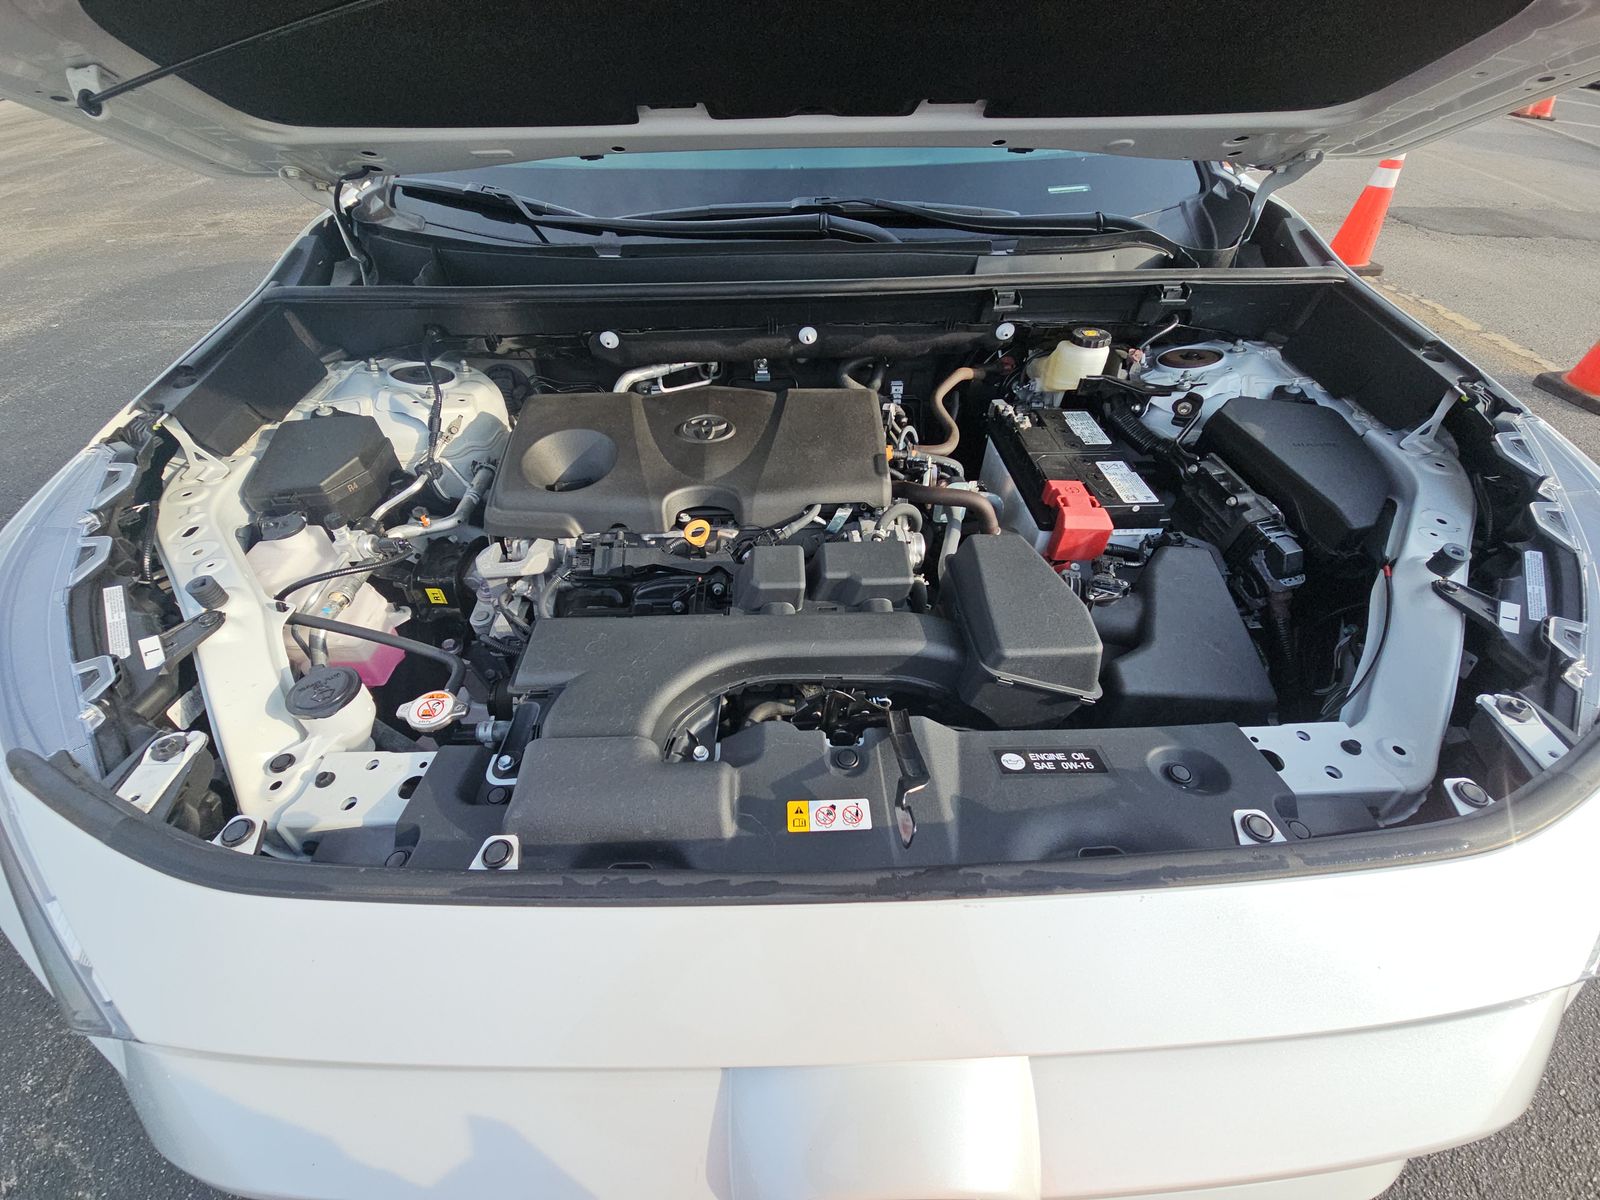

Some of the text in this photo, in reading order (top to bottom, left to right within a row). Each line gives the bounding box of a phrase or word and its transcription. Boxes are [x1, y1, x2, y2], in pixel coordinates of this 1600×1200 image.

[1028, 752, 1090, 761] ENGINE OIL
[1033, 761, 1095, 770] SAE 0W-16
